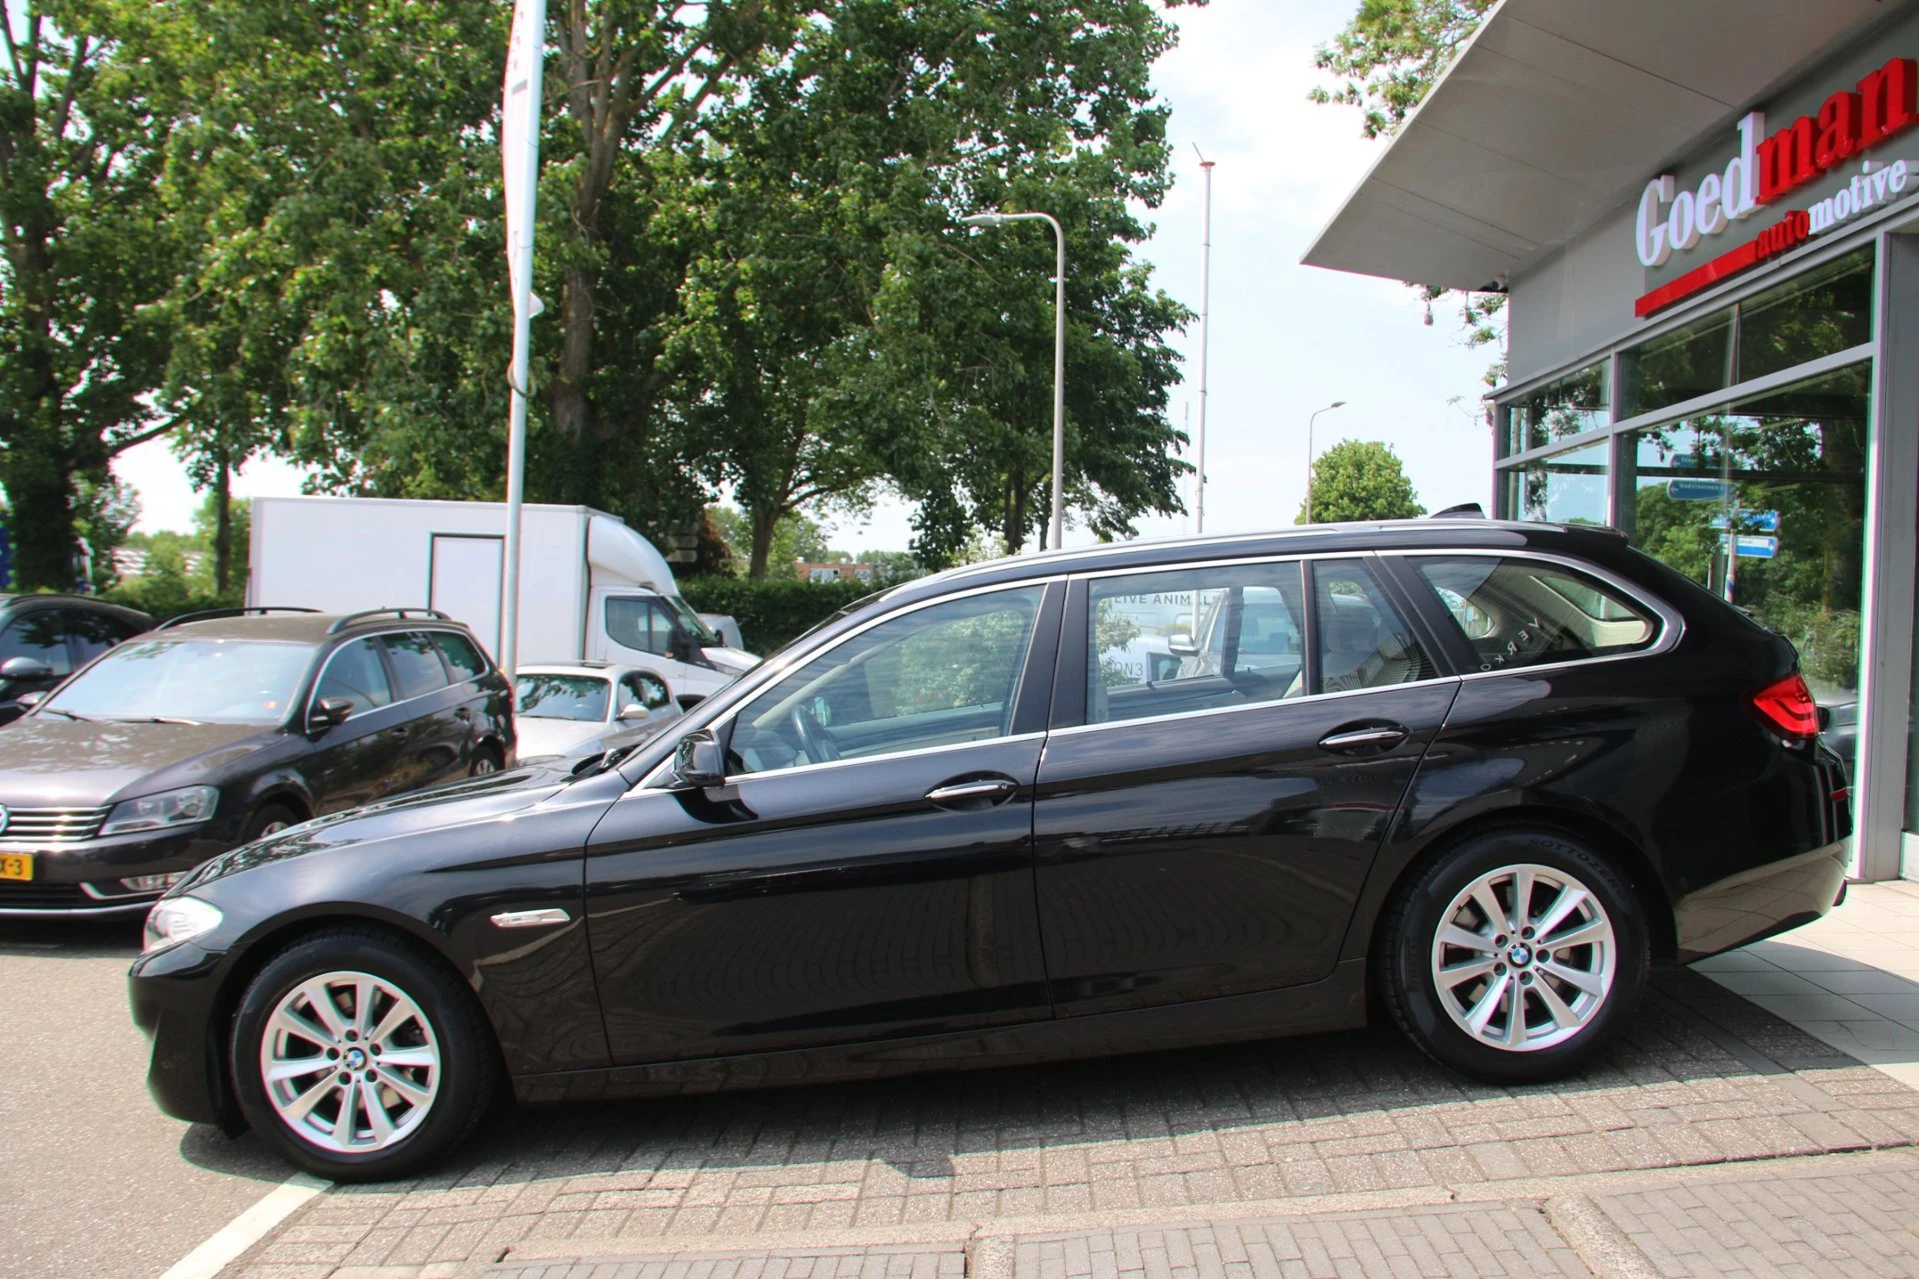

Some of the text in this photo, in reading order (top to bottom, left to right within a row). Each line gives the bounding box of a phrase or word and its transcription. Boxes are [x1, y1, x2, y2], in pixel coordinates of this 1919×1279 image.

[1635, 57, 1918, 268] Goedman
[1755, 159, 1915, 260] automotive
[1153, 594, 1218, 606] ANIML
